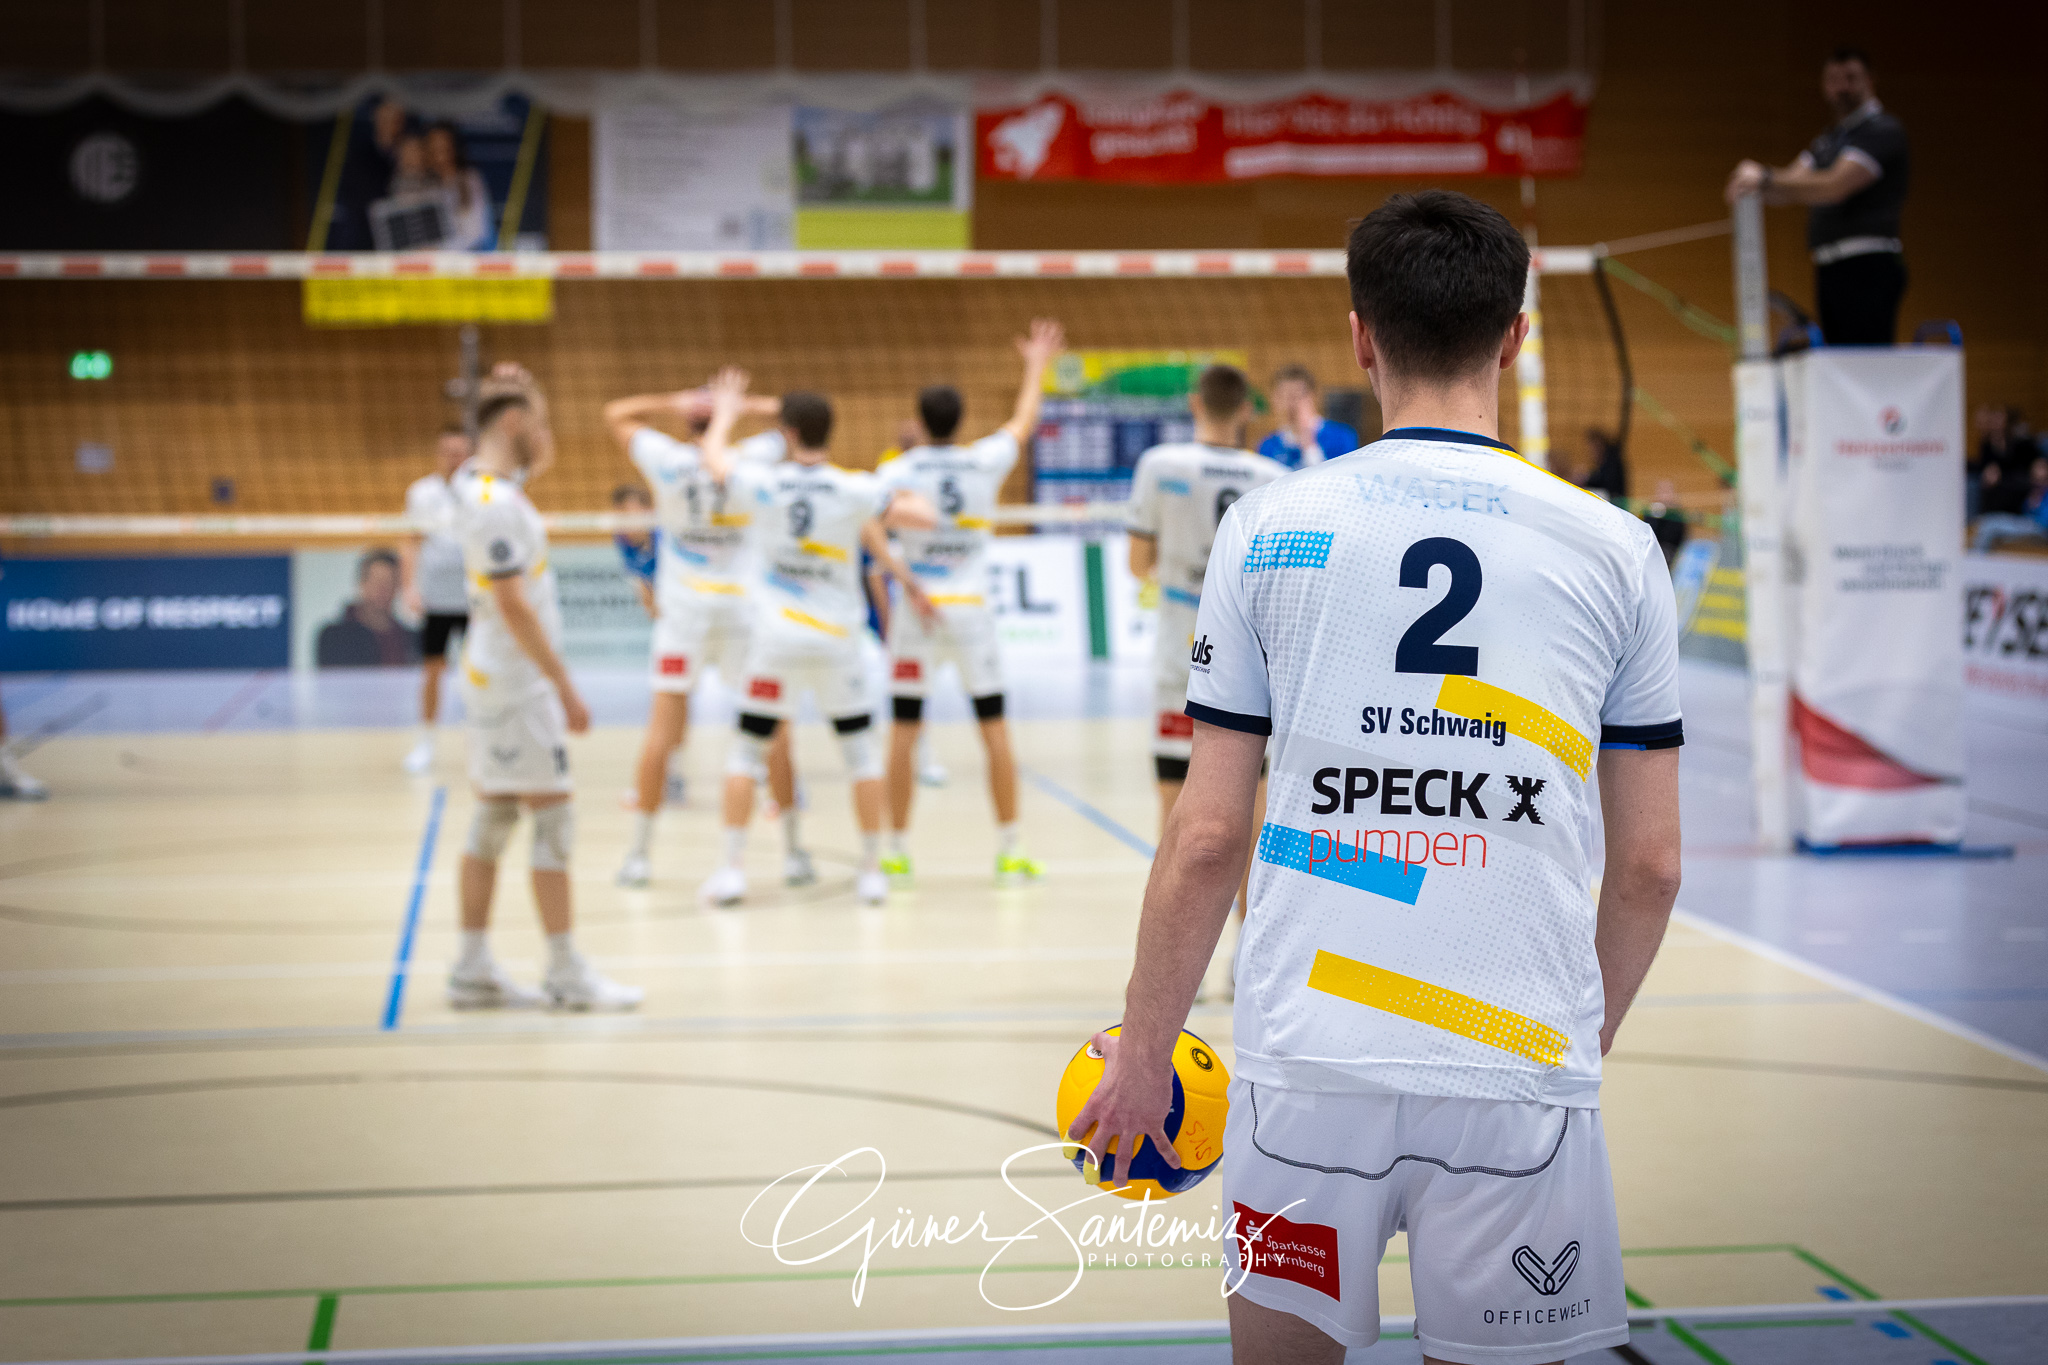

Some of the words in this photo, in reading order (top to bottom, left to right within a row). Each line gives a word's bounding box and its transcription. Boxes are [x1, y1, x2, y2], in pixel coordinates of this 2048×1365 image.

[939, 476, 964, 515] 5
[788, 498, 814, 539] 9
[104, 598, 143, 627] OF
[150, 597, 282, 627] RESPECT
[1395, 537, 1483, 677] 2
[1191, 634, 1213, 665] uls
[1361, 706, 1392, 733] SV
[1400, 708, 1507, 747] Schwaig
[1311, 767, 1491, 820] SPECK
[1308, 829, 1487, 876] pumpen
[1266, 1235, 1327, 1259] Sparkasse
[1483, 1298, 1591, 1325] OFFICEWELT
